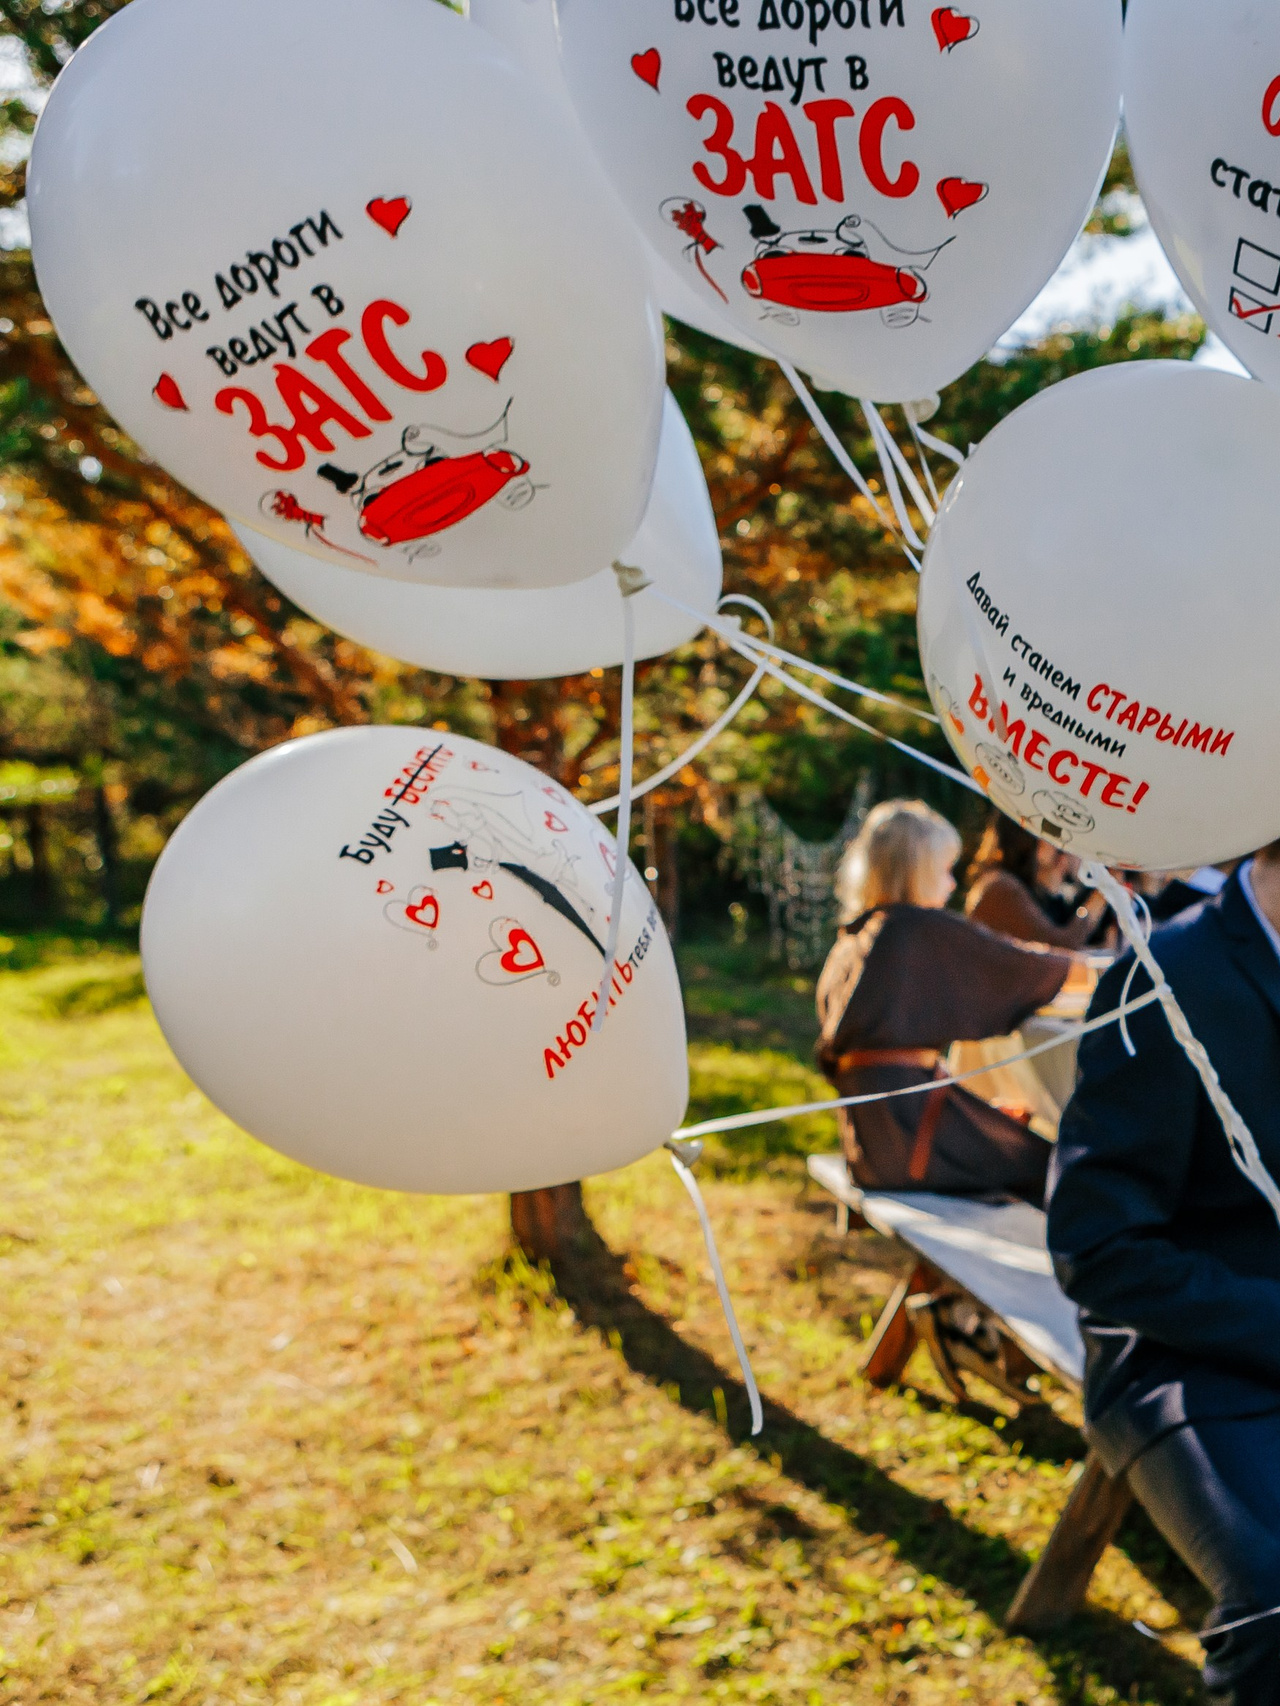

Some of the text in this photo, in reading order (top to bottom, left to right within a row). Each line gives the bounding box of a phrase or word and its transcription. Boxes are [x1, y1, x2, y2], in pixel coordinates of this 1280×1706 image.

[712, 51, 870, 106] ведут в
[684, 93, 920, 206] ЗАГС
[134, 209, 345, 341] Все дороги
[205, 283, 345, 377] ведут в
[214, 299, 448, 473] ЗАГС
[1002, 666, 1128, 759] и вредными
[1010, 633, 1082, 702] станем
[1086, 683, 1235, 757] СТАРЫМИ
[339, 808, 411, 865] Буду
